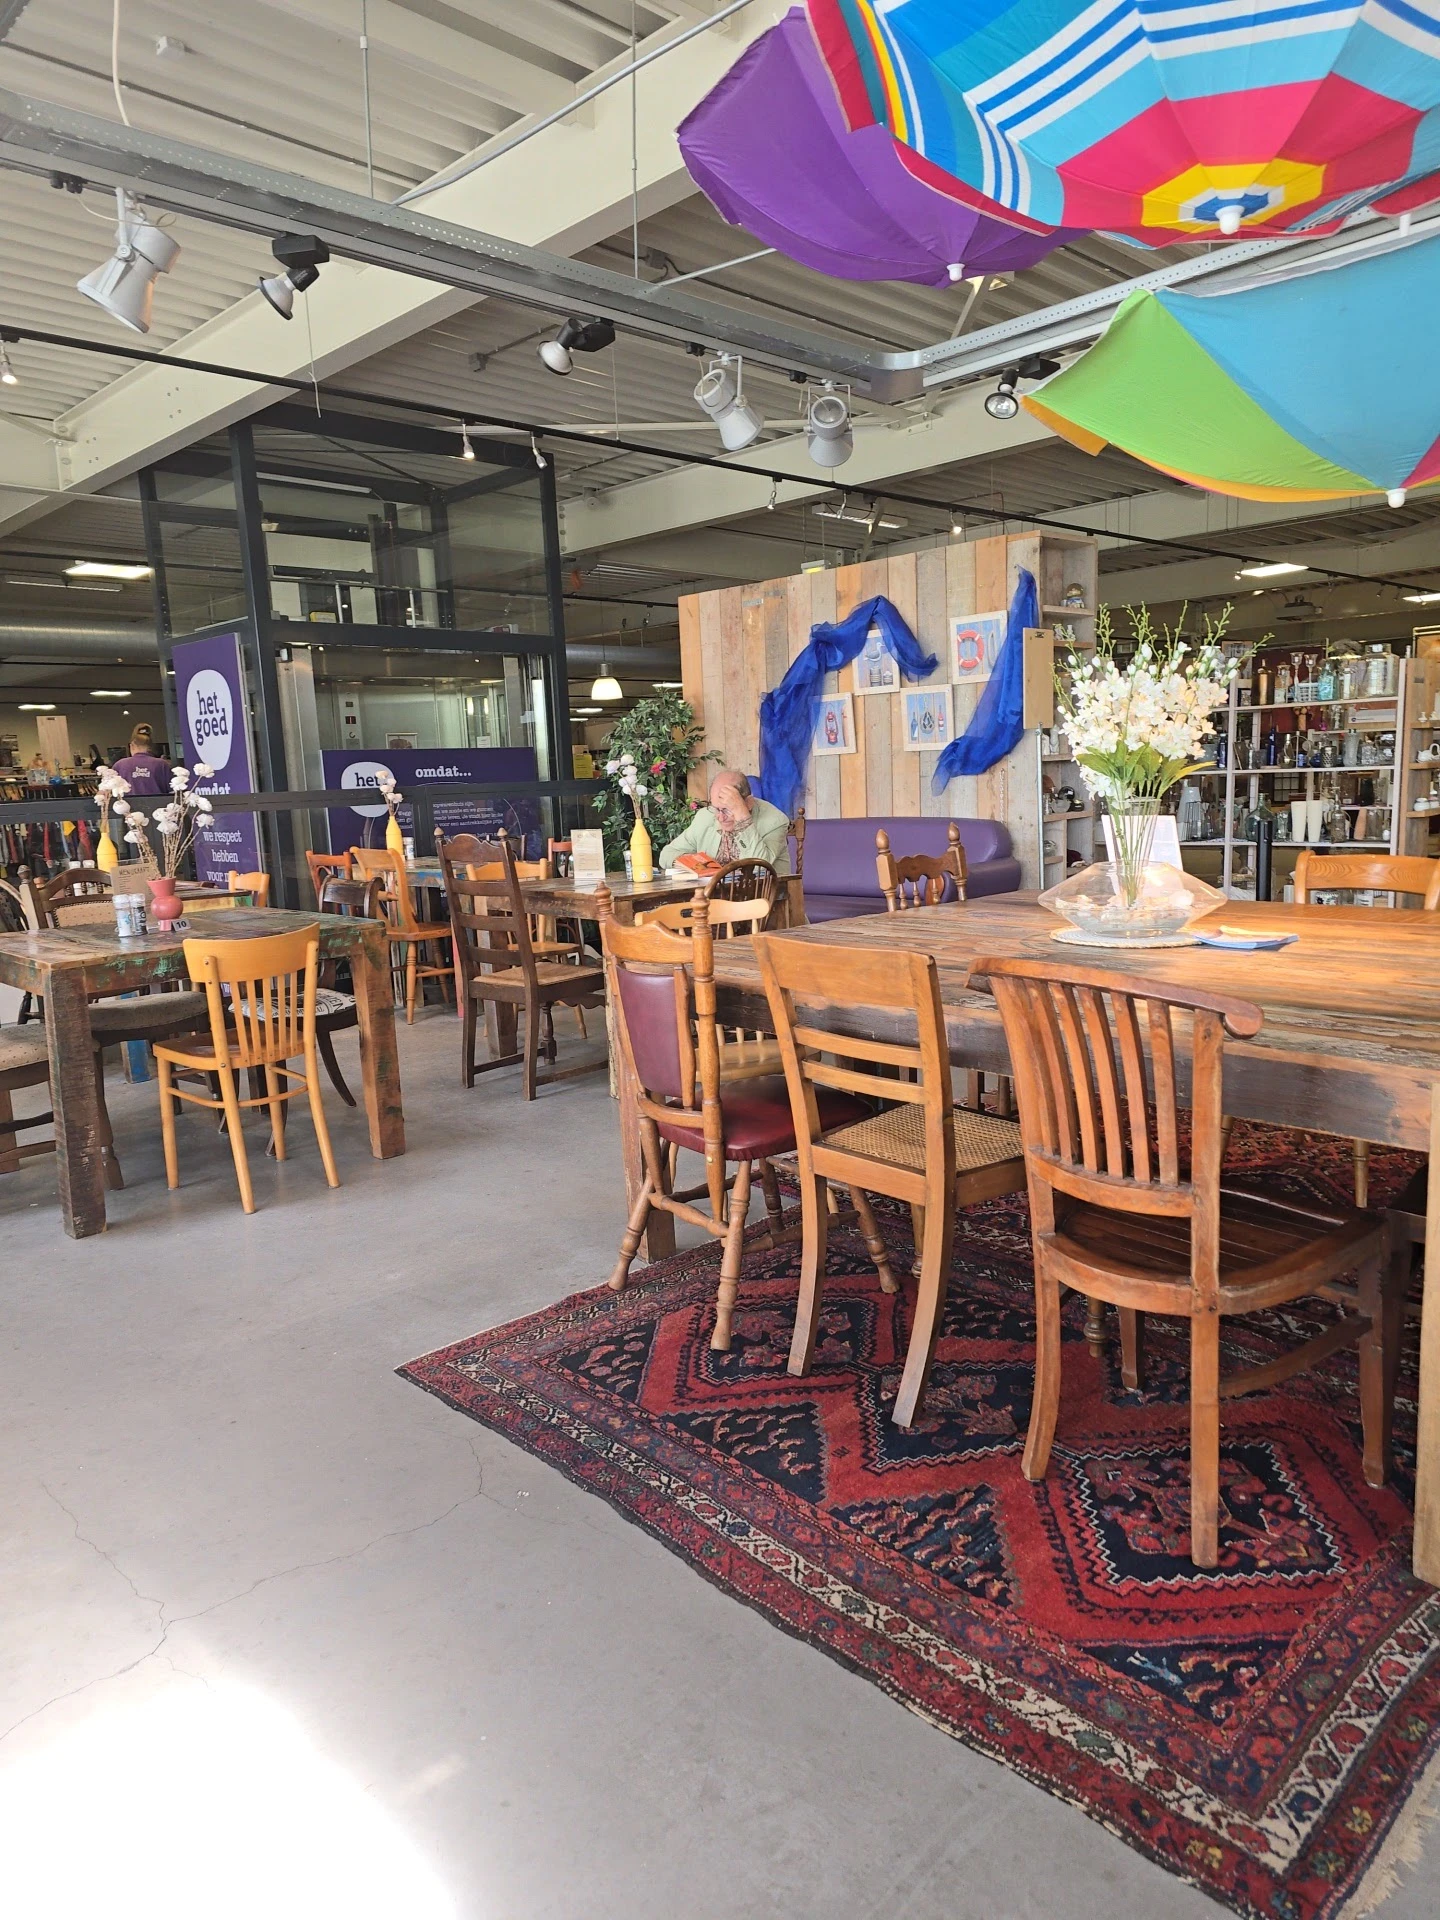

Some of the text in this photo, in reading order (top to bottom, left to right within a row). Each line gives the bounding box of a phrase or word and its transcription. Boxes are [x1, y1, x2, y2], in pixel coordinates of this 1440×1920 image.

[196, 690, 220, 715] het
[195, 708, 229, 746] goed
[415, 766, 472, 778] omdat...
[203, 830, 243, 845] we respect
[211, 849, 239, 863] hebben
[206, 871, 223, 882] voor
[176, 920, 187, 929] 10
